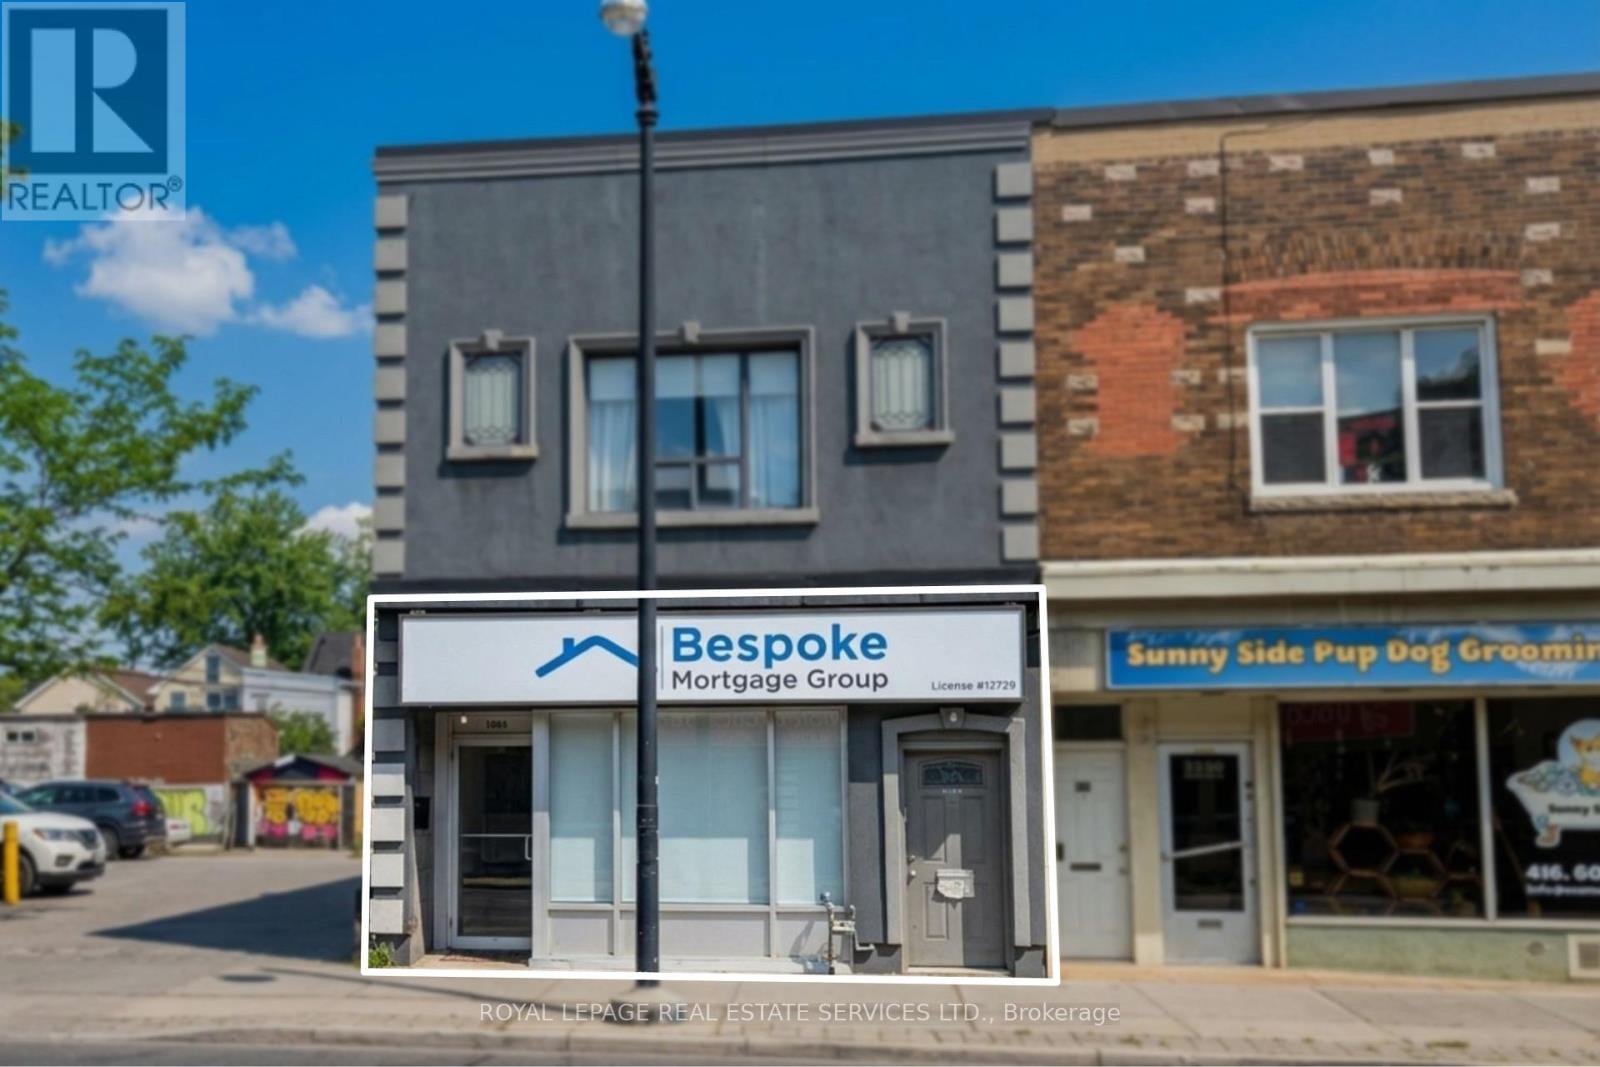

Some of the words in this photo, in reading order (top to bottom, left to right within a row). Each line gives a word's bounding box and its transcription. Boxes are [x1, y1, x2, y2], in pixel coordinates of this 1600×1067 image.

[672, 623, 888, 668] Bespoke
[1127, 643, 1229, 674] Sunny
[1237, 640, 1305, 665] Side
[1313, 640, 1378, 673] Pup
[1386, 639, 1451, 674] Dog
[672, 669, 798, 693] Mortgage
[806, 668, 888, 692] Group
[931, 681, 974, 691] License
[976, 680, 1016, 691] #12729
